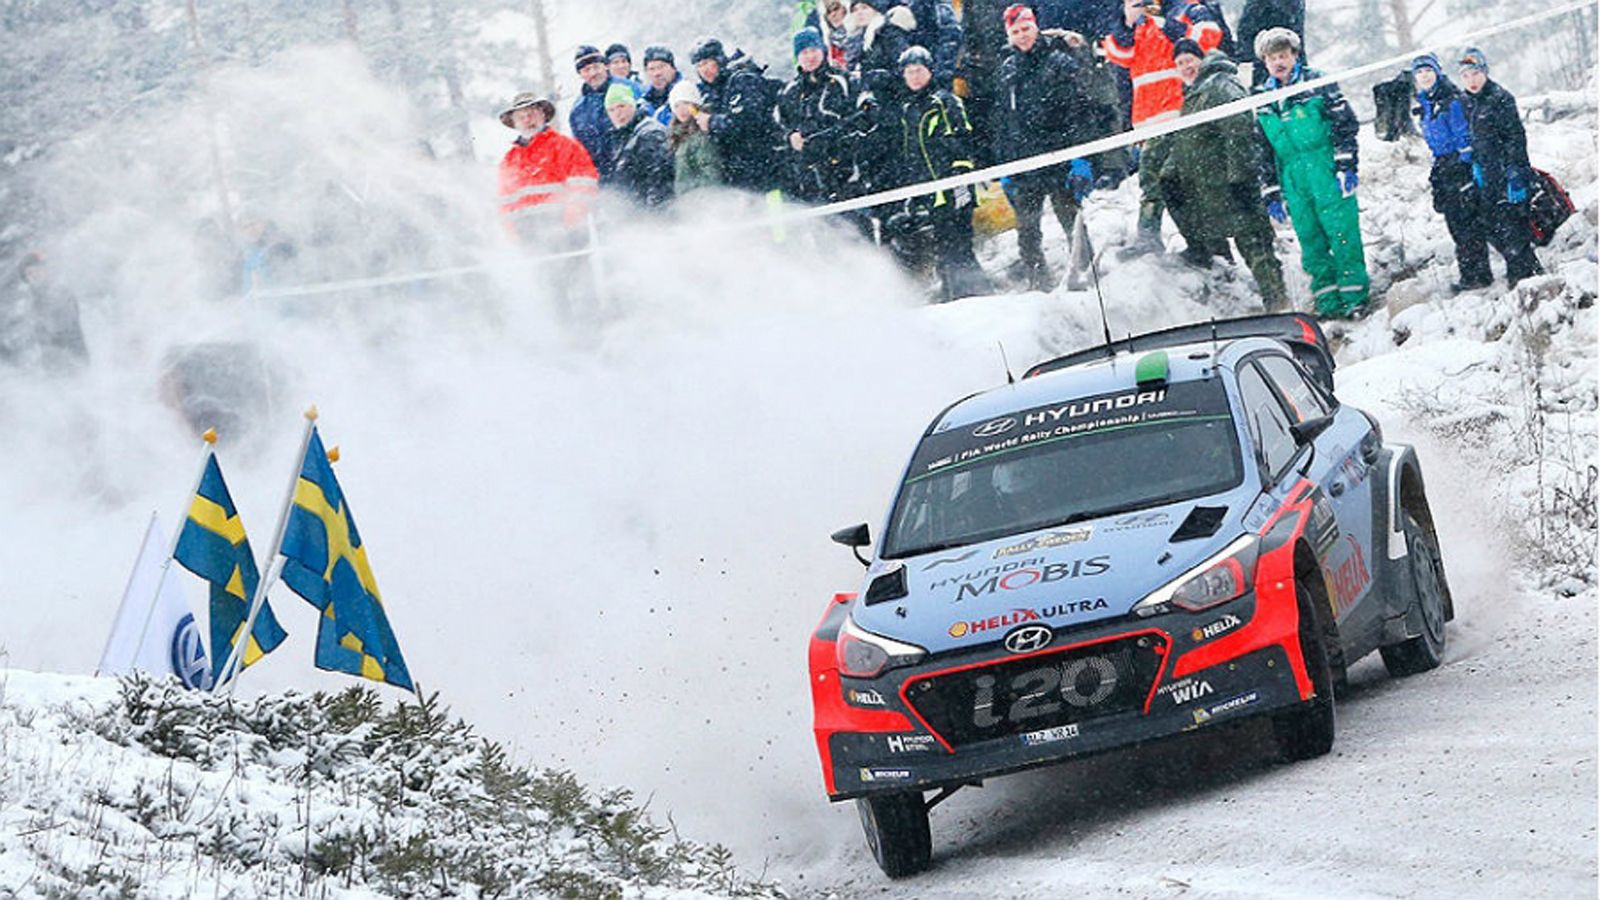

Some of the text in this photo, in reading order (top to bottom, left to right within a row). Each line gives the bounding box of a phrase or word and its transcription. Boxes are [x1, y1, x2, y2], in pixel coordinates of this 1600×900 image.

[1025, 389, 1165, 426] HYUNDAI
[984, 436, 1018, 453] World
[1020, 430, 1051, 445] Rally
[1054, 413, 1140, 434] Championship
[929, 557, 1045, 591] HYUNDAI
[956, 555, 1111, 602] MOBIS
[970, 598, 1109, 634] HELIX ULTRA
[1202, 614, 1241, 638] HELIX
[973, 655, 1119, 729] i20
